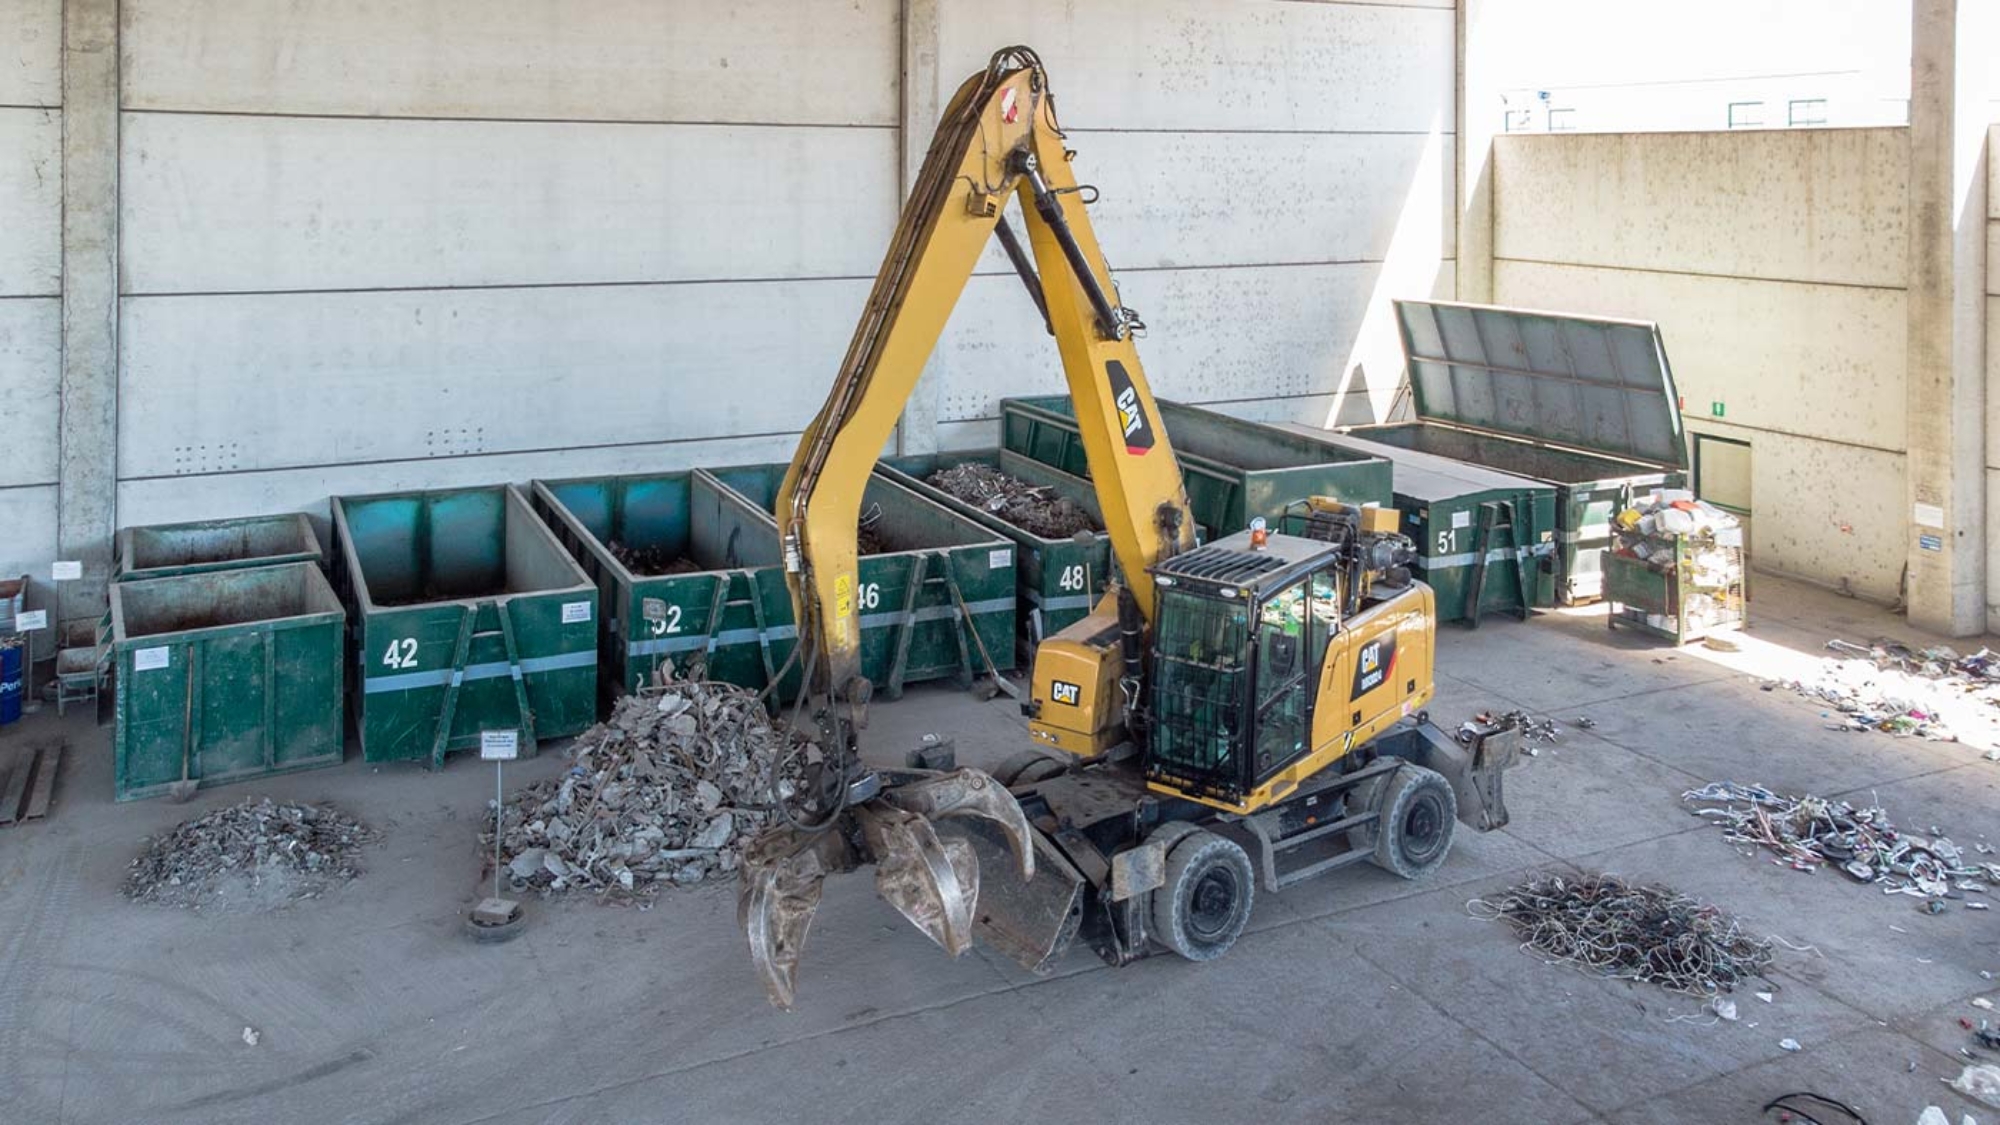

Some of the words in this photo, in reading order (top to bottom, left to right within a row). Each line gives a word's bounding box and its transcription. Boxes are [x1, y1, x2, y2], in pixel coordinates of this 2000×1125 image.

[1117, 386, 1143, 438] CAT
[1438, 529, 1456, 553] 51
[1060, 565, 1083, 591] 48
[383, 637, 418, 669] 42
[1362, 642, 1380, 674] CAT
[1053, 682, 1078, 704] CAT
